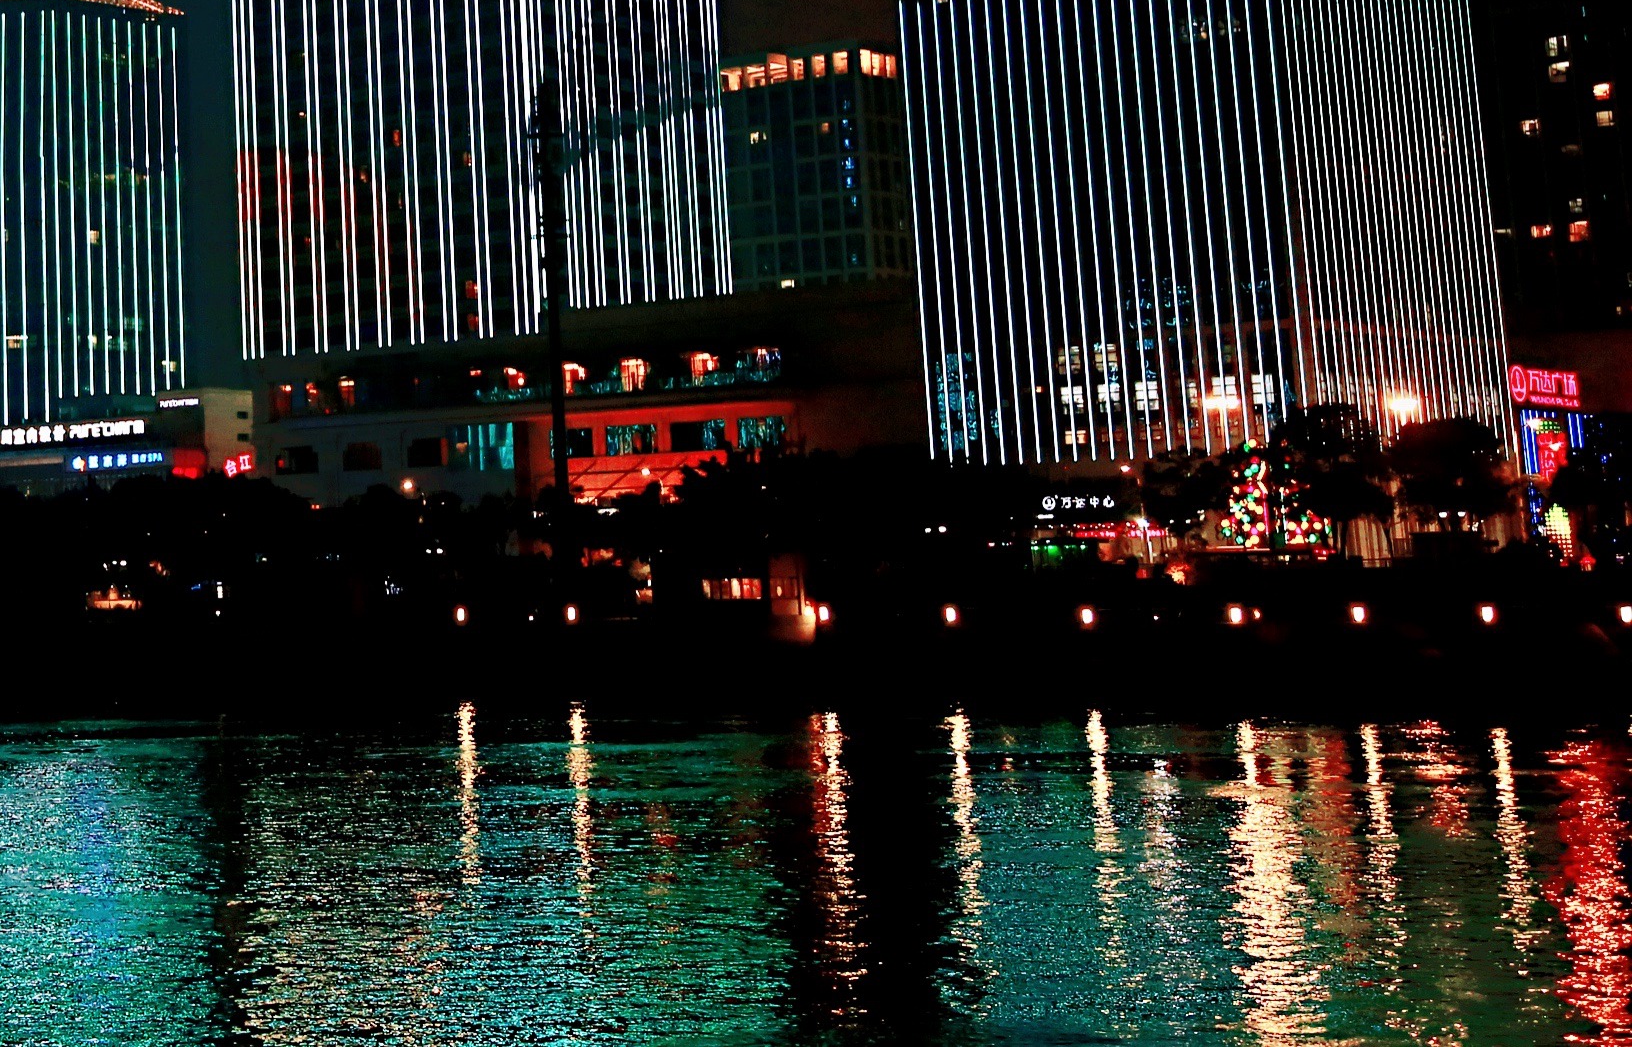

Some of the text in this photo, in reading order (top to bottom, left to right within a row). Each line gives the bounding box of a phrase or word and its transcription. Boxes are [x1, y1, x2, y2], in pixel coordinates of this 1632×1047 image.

[1526, 370, 1577, 396] 万达广场
[225, 454, 252, 478] 台江
[1060, 495, 1115, 509] 万达中心
